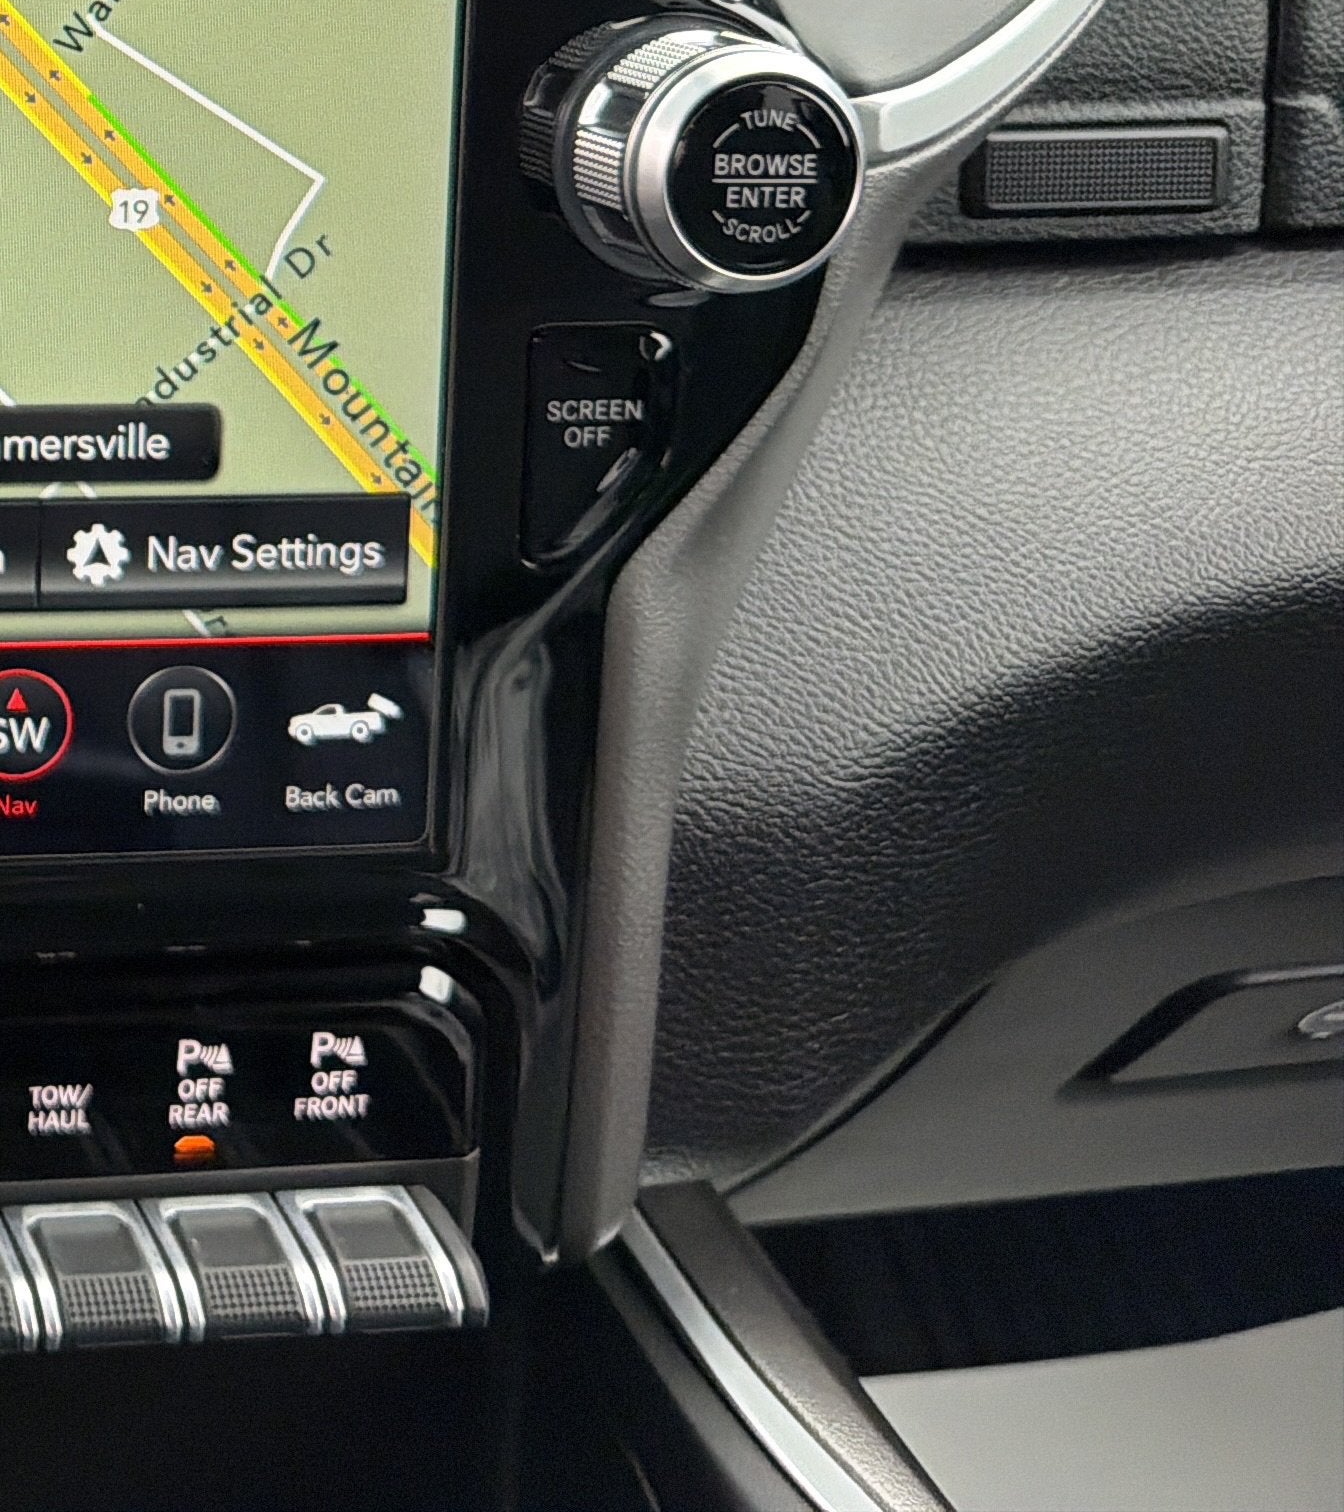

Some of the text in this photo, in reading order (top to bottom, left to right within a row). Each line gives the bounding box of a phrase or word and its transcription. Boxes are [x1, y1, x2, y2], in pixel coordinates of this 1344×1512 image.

[740, 109, 799, 133] TUNE
[714, 153, 817, 177] BROWSE
[725, 185, 806, 210] ENTER
[118, 198, 150, 224] 19
[722, 217, 801, 244] SCROLL
[284, 234, 332, 280] Dr
[547, 399, 643, 422] SCREEN
[564, 426, 612, 447] OFF
[147, 528, 387, 576] Nav Settings
[143, 789, 220, 815] Phone
[285, 784, 402, 811] Back Cam
[178, 1077, 224, 1103] OFF
[311, 1070, 358, 1095] OFF
[29, 1083, 94, 1109] TOW/
[294, 1093, 370, 1120] FRONT
[28, 1108, 90, 1135] HAUL
[169, 1102, 230, 1128] REAR
